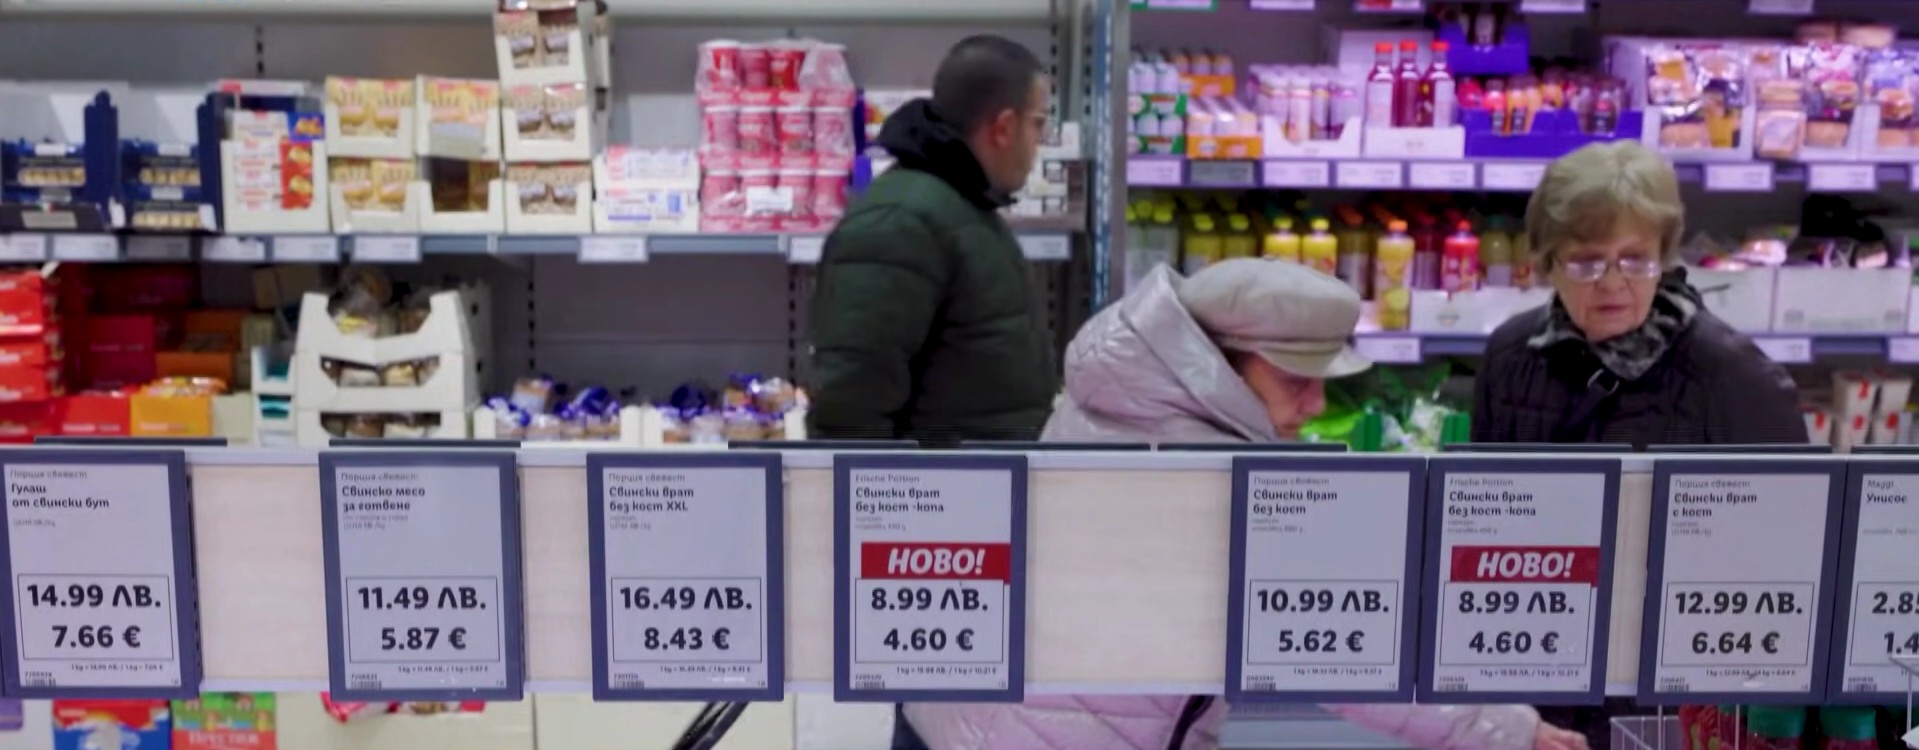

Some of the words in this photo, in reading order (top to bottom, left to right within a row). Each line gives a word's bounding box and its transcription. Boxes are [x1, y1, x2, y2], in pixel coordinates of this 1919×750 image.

[12, 483, 46, 494] Гулаш
[342, 486, 392, 496] Свинско
[396, 487, 425, 497] месо
[610, 487, 659, 497] Свински
[663, 487, 693, 499] врат
[856, 488, 905, 498] Свински
[909, 488, 939, 499] врат
[1254, 490, 1303, 500] Свински
[1307, 490, 1337, 502] врат
[1450, 491, 1498, 501] Свински
[1502, 492, 1532, 503] врат
[1675, 493, 1722, 503] Свински
[1727, 493, 1757, 504] врат
[1867, 493, 1906, 503] Унисос
[33, 497, 82, 507] свински
[86, 497, 109, 509] бут
[344, 503, 355, 512] за
[359, 500, 410, 510] готвене
[610, 501, 629, 513] без
[633, 501, 662, 511] кост
[667, 501, 687, 510] XXL
[856, 501, 875, 514] без
[879, 502, 908, 511] кост
[1253, 504, 1272, 516] без
[1276, 504, 1305, 514] кост
[1449, 505, 1468, 517] без
[1471, 506, 1501, 515] кост
[1682, 507, 1712, 516] кост
[888, 548, 985, 574] НОВО!
[1477, 552, 1574, 577] НОВО!
[27, 584, 103, 607] 14.99
[112, 585, 160, 607] ЛВ.
[358, 587, 428, 609] 11.49
[438, 587, 486, 609] ЛВ.
[620, 587, 695, 609] 16.49
[704, 587, 752, 609] ЛВ.
[872, 588, 932, 610] 8.99
[940, 588, 987, 611] ЛВ.
[1258, 589, 1333, 612] 10.99
[1341, 590, 1388, 612] ЛВ.
[1459, 591, 1519, 613] 8.99
[1527, 591, 1574, 613] ЛВ.
[1675, 592, 1748, 614] 12.99
[1755, 592, 1802, 614] ЛВ.
[1873, 592, 1919, 614] 2.8
[52, 625, 113, 648] 7.66
[123, 626, 140, 648] €
[382, 627, 439, 650] 5.87
[448, 627, 466, 650] €
[645, 627, 702, 650] 8.43
[712, 627, 730, 650] €
[884, 628, 946, 651] 4.60
[956, 629, 974, 651] €
[1279, 630, 1336, 652] 5.62
[1346, 631, 1364, 652] €
[1469, 631, 1531, 653] 4.60
[1541, 632, 1559, 653] €
[1692, 632, 1752, 654] 6.64
[1761, 632, 1780, 654] €
